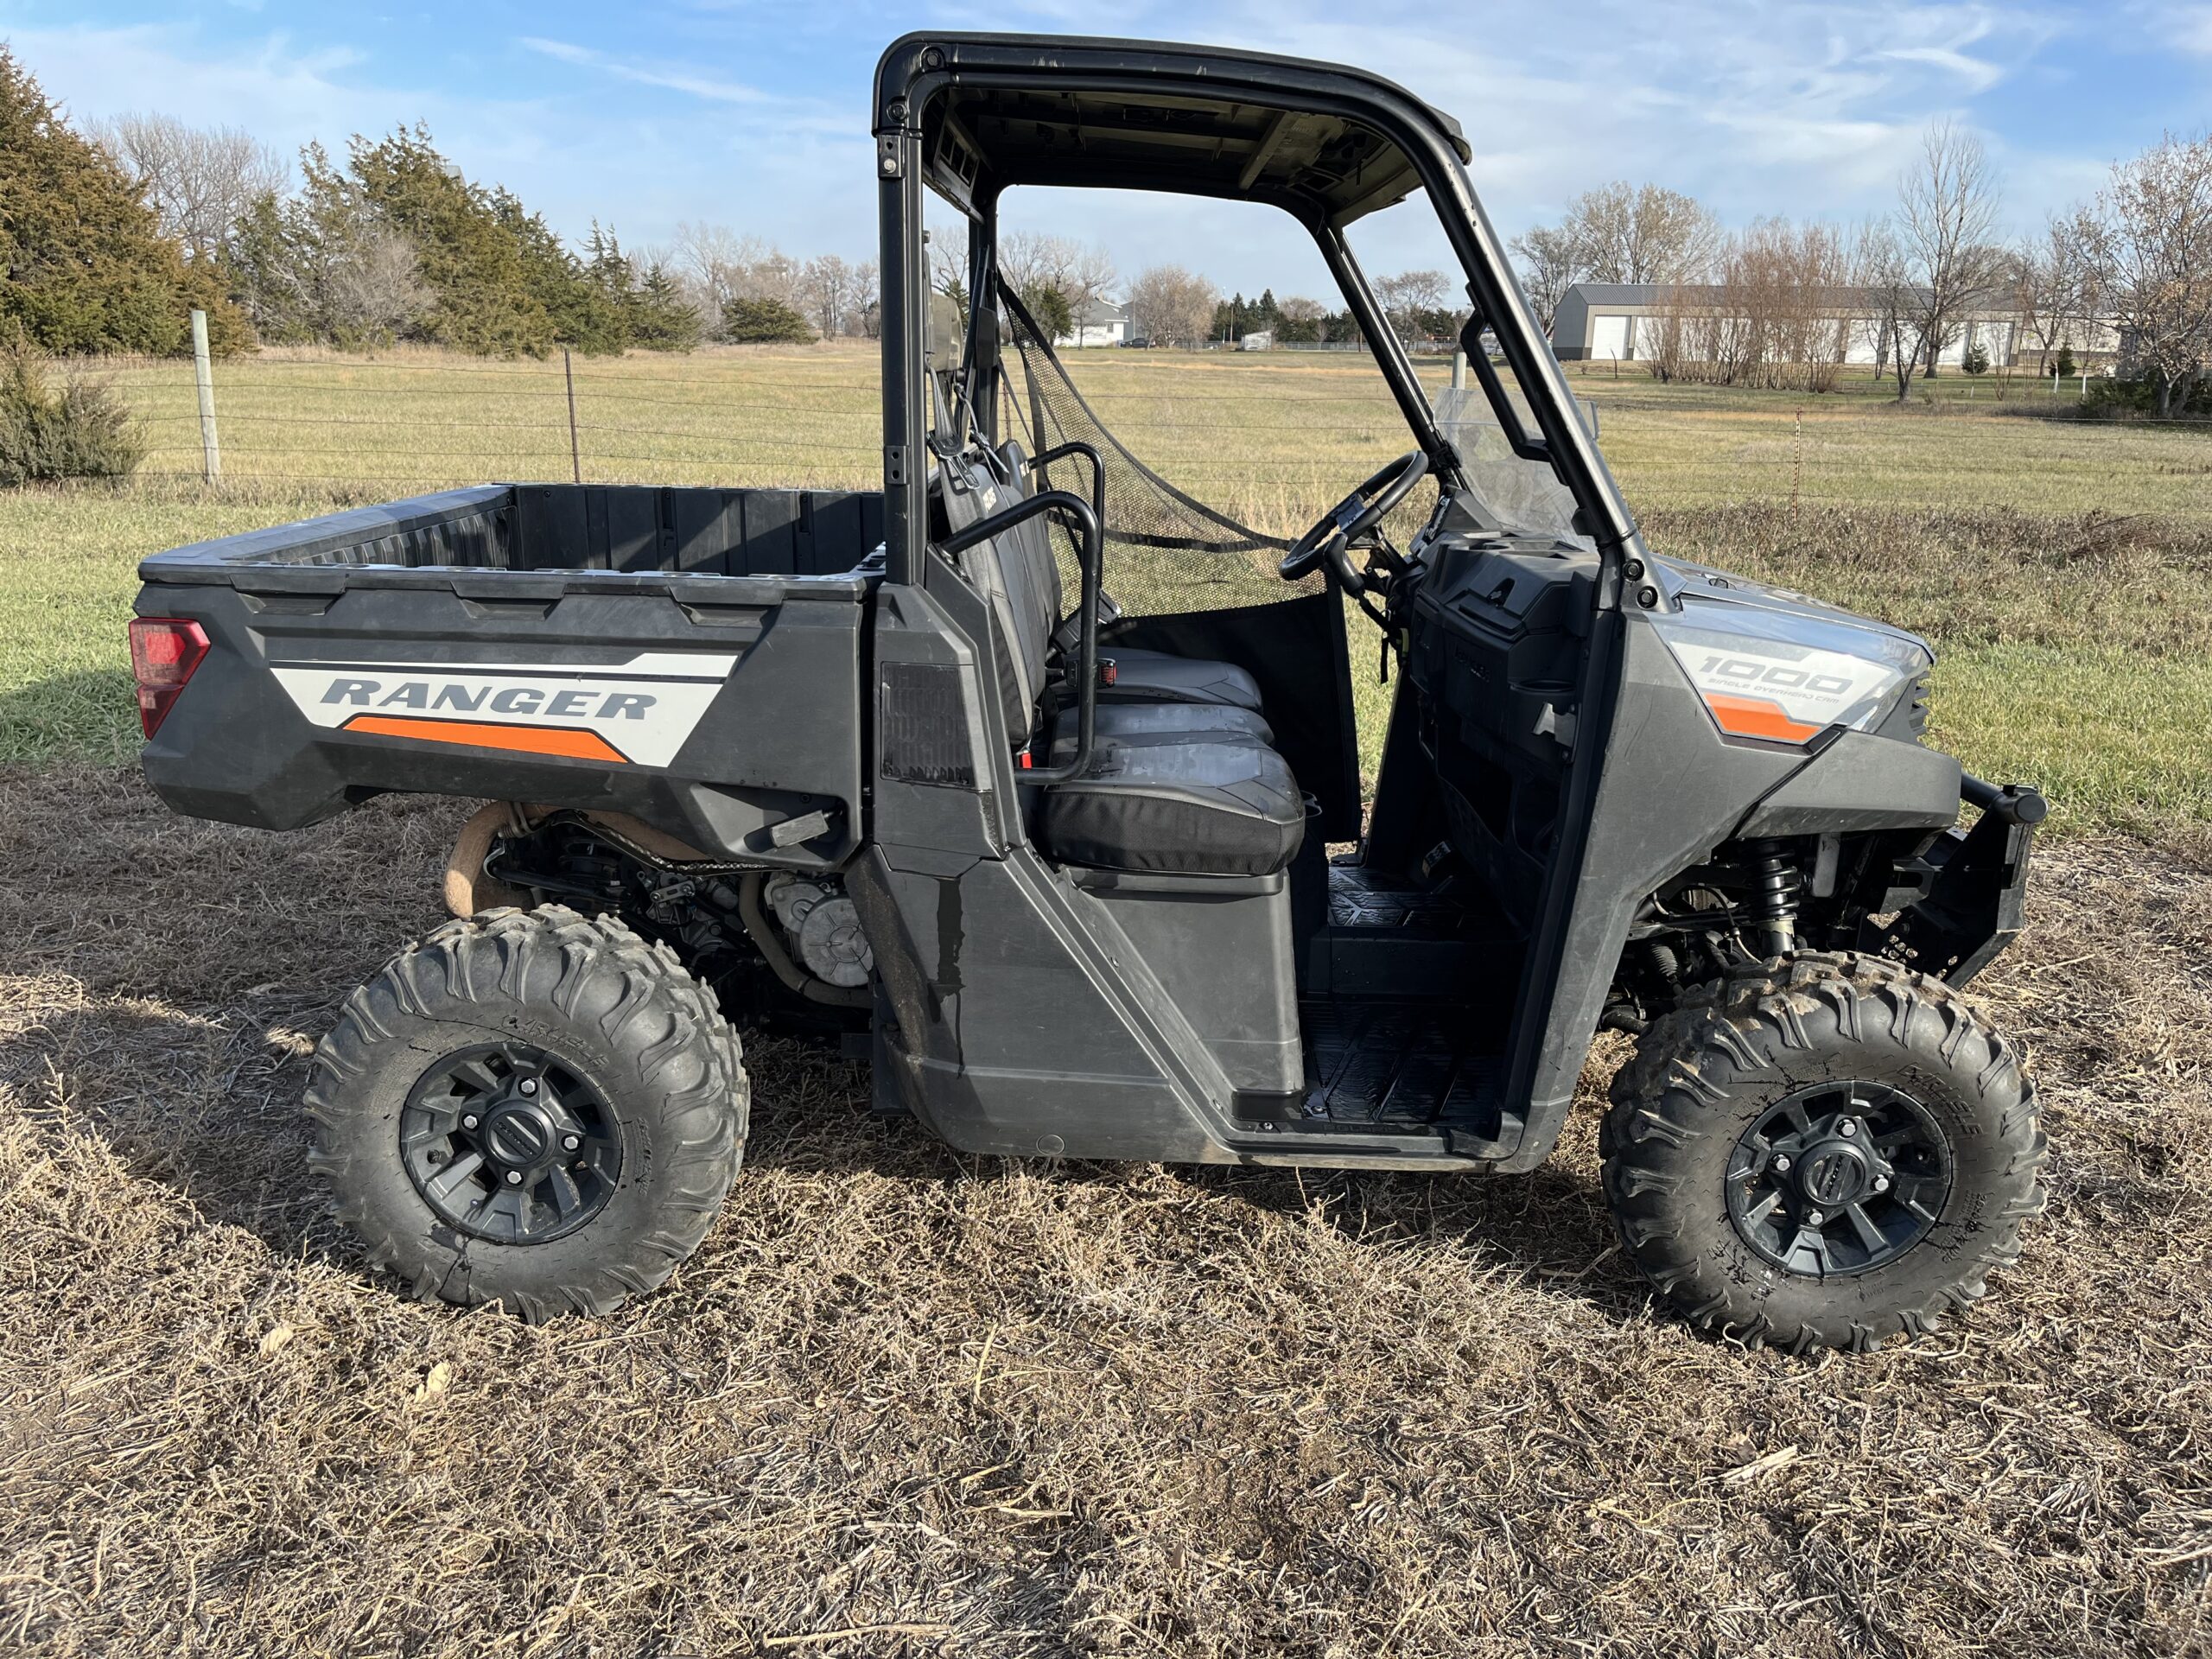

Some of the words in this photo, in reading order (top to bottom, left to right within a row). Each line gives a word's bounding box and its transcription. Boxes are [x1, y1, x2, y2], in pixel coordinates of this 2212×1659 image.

[1700, 656, 1853, 695] 1000
[1707, 677, 1751, 689] SINGLE
[1815, 696, 1840, 704] CAM
[320, 678, 658, 720] RANGER
